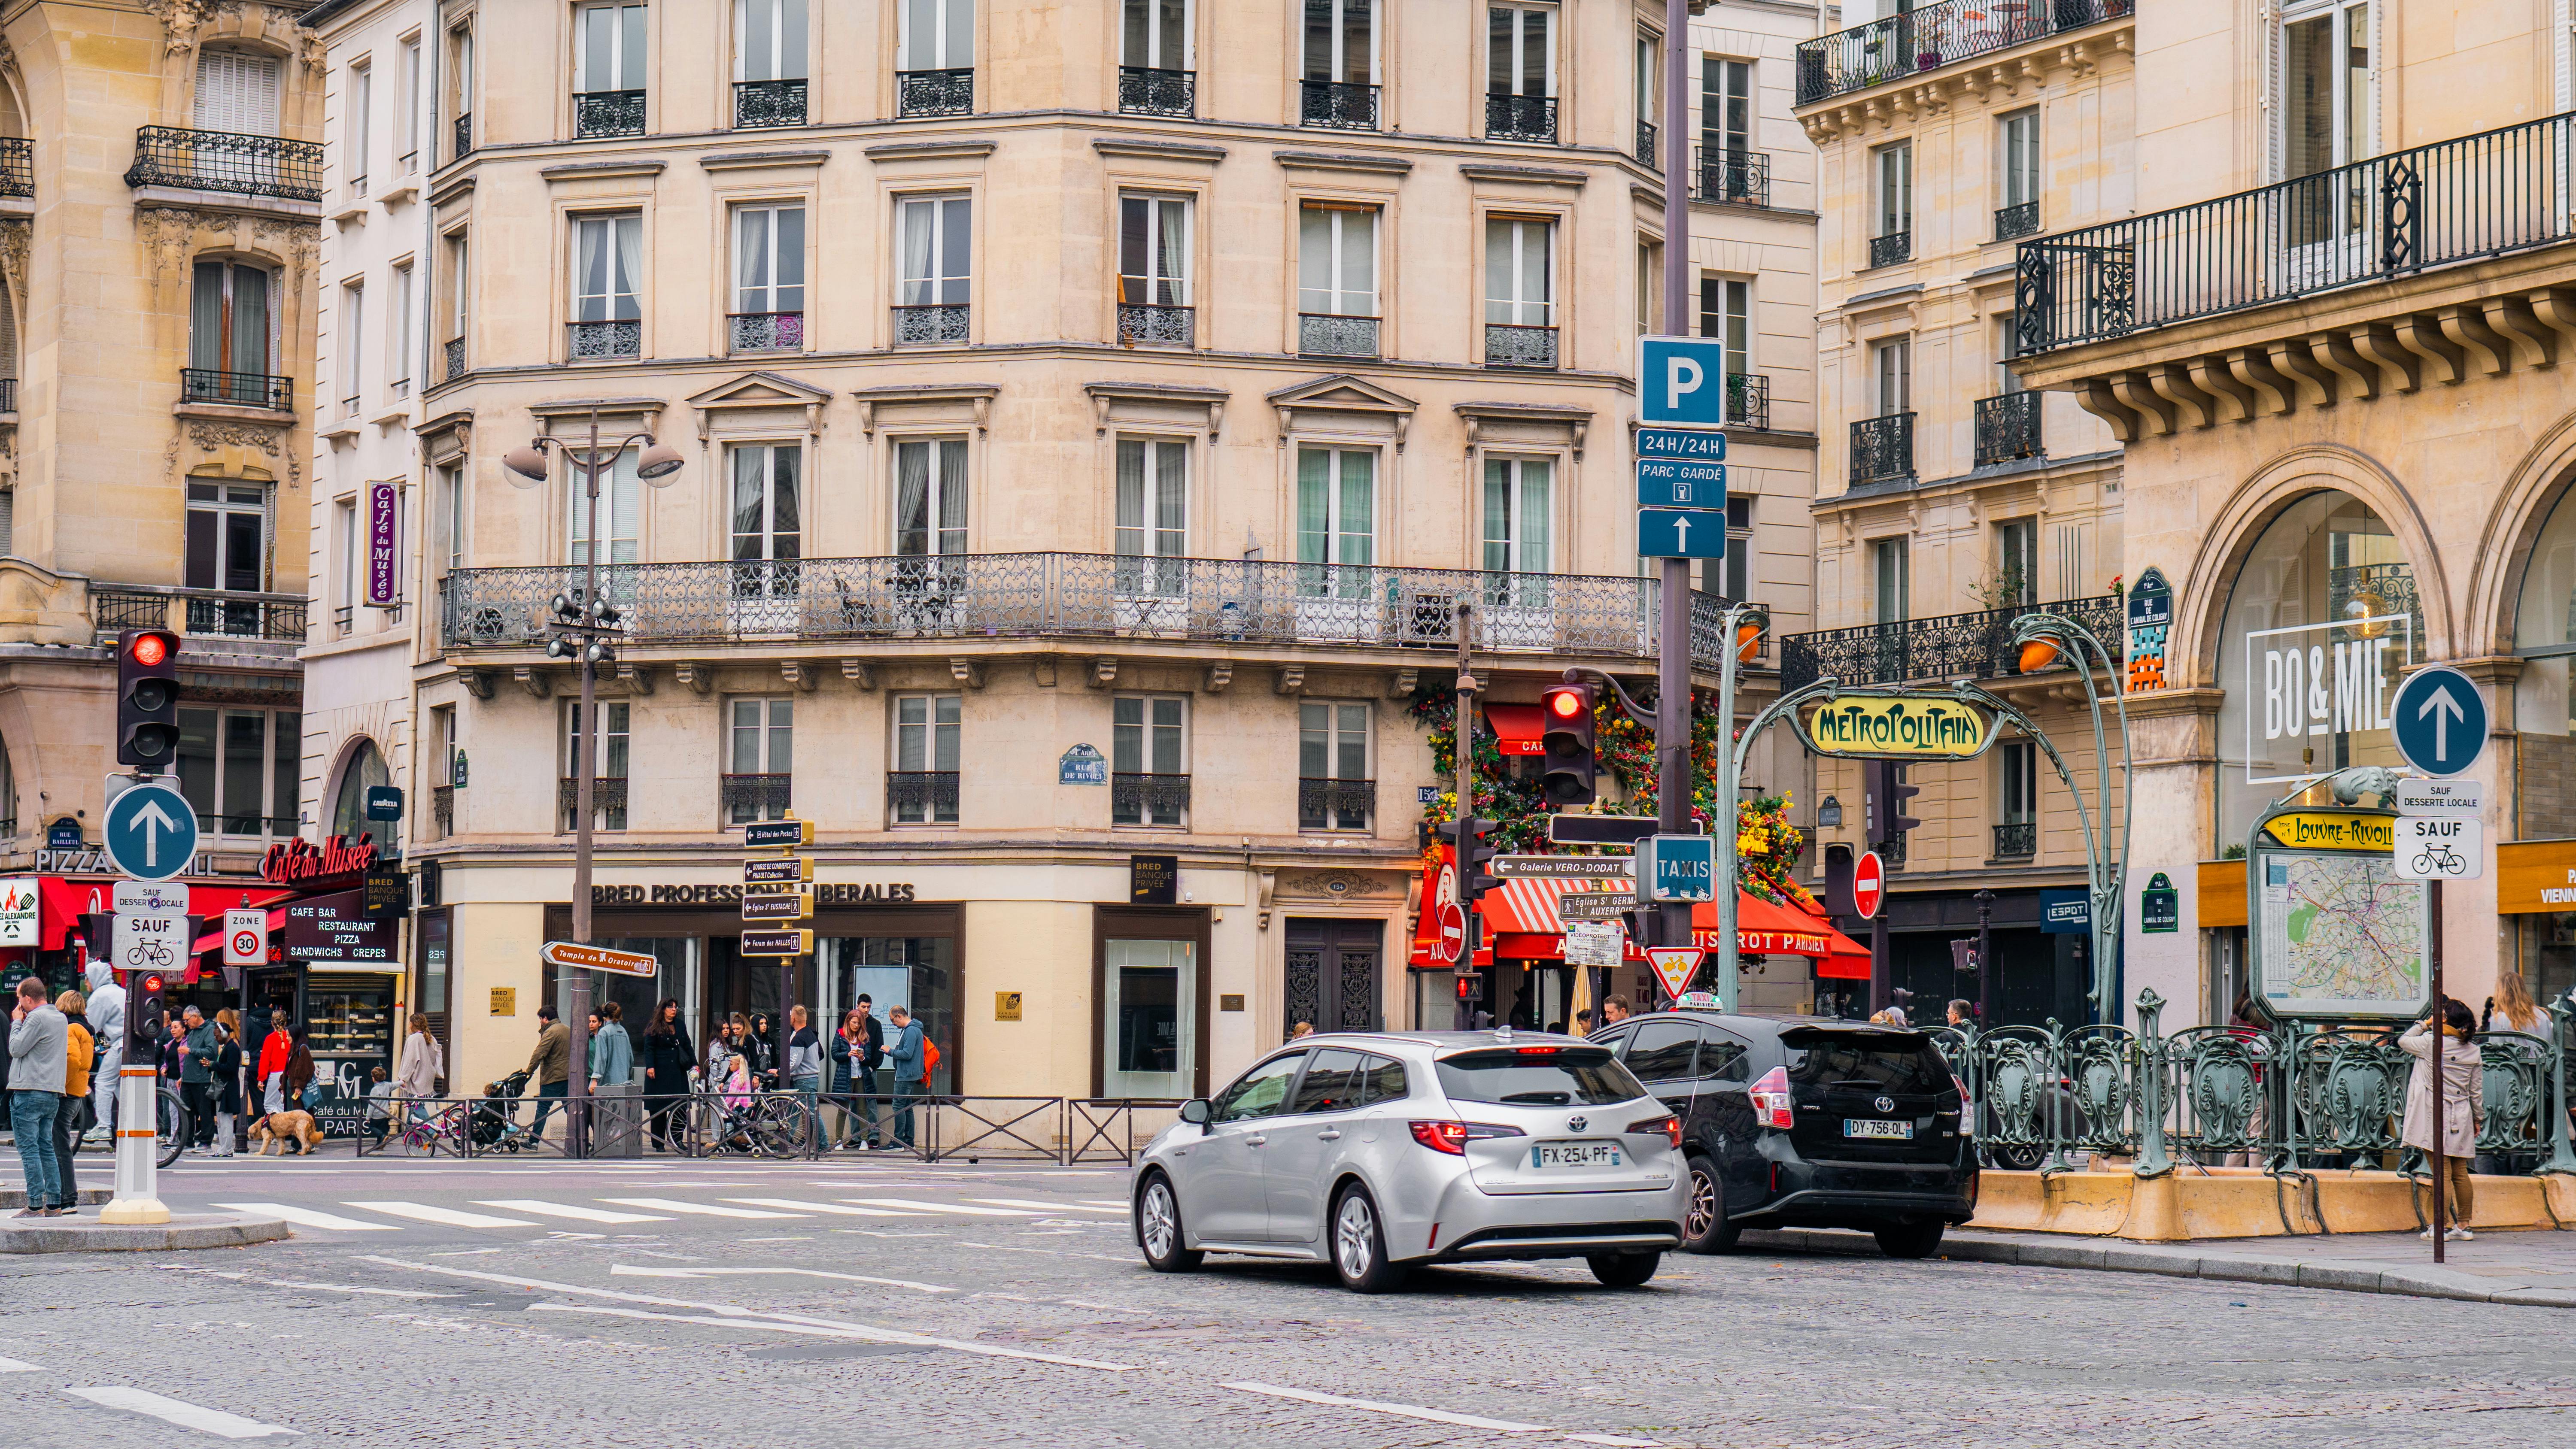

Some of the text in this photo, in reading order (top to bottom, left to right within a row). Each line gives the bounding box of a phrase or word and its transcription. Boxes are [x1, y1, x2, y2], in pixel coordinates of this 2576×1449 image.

[1668, 357, 1703, 409] P
[1646, 436, 1719, 454] 24H/24H
[1642, 465, 1722, 481] PARC GARDÉ
[373, 487, 392, 598] Café du Musée
[2130, 615, 2147, 624] L'AMIRAL
[2152, 612, 2167, 621] COLIGNY
[1820, 703, 1977, 749] METROPOLITAIN
[1522, 741, 1546, 752] CAF
[2404, 798, 2444, 806] DESSERTE
[2416, 822, 2462, 836] SAUF
[36, 850, 112, 873] PIZZA
[264, 837, 306, 884] Café
[301, 846, 319, 879] du
[319, 831, 374, 876] Musée
[1520, 862, 1552, 872] Galerie
[1659, 860, 1709, 877] TAXIS
[1136, 879, 1164, 887] PRIVÉE
[369, 894, 396, 902] PRIVÉE
[591, 885, 645, 902] BRED
[651, 884, 794, 902] PROFESSION
[120, 898, 151, 906] DESSERT
[752, 903, 764, 912] Église
[1576, 897, 1597, 907] Eglise
[292, 907, 336, 917] CAFE BAR
[132, 919, 171, 932] SAUF
[319, 921, 375, 931] RESTAURANT
[238, 938, 254, 949] 30
[335, 935, 360, 944] PIZZA
[1692, 931, 1825, 952] BISROT PARISIEN
[291, 947, 342, 957] SANDWICHS
[353, 948, 386, 958] CREPES
[559, 950, 584, 961] Temple
[1692, 993, 1710, 1002] TAXI
[337, 1106, 349, 1116] du
[325, 1121, 371, 1134] PARS
[1852, 1121, 1905, 1135] DY-756-QL
[1543, 1147, 1608, 1163] FX-254-PF
